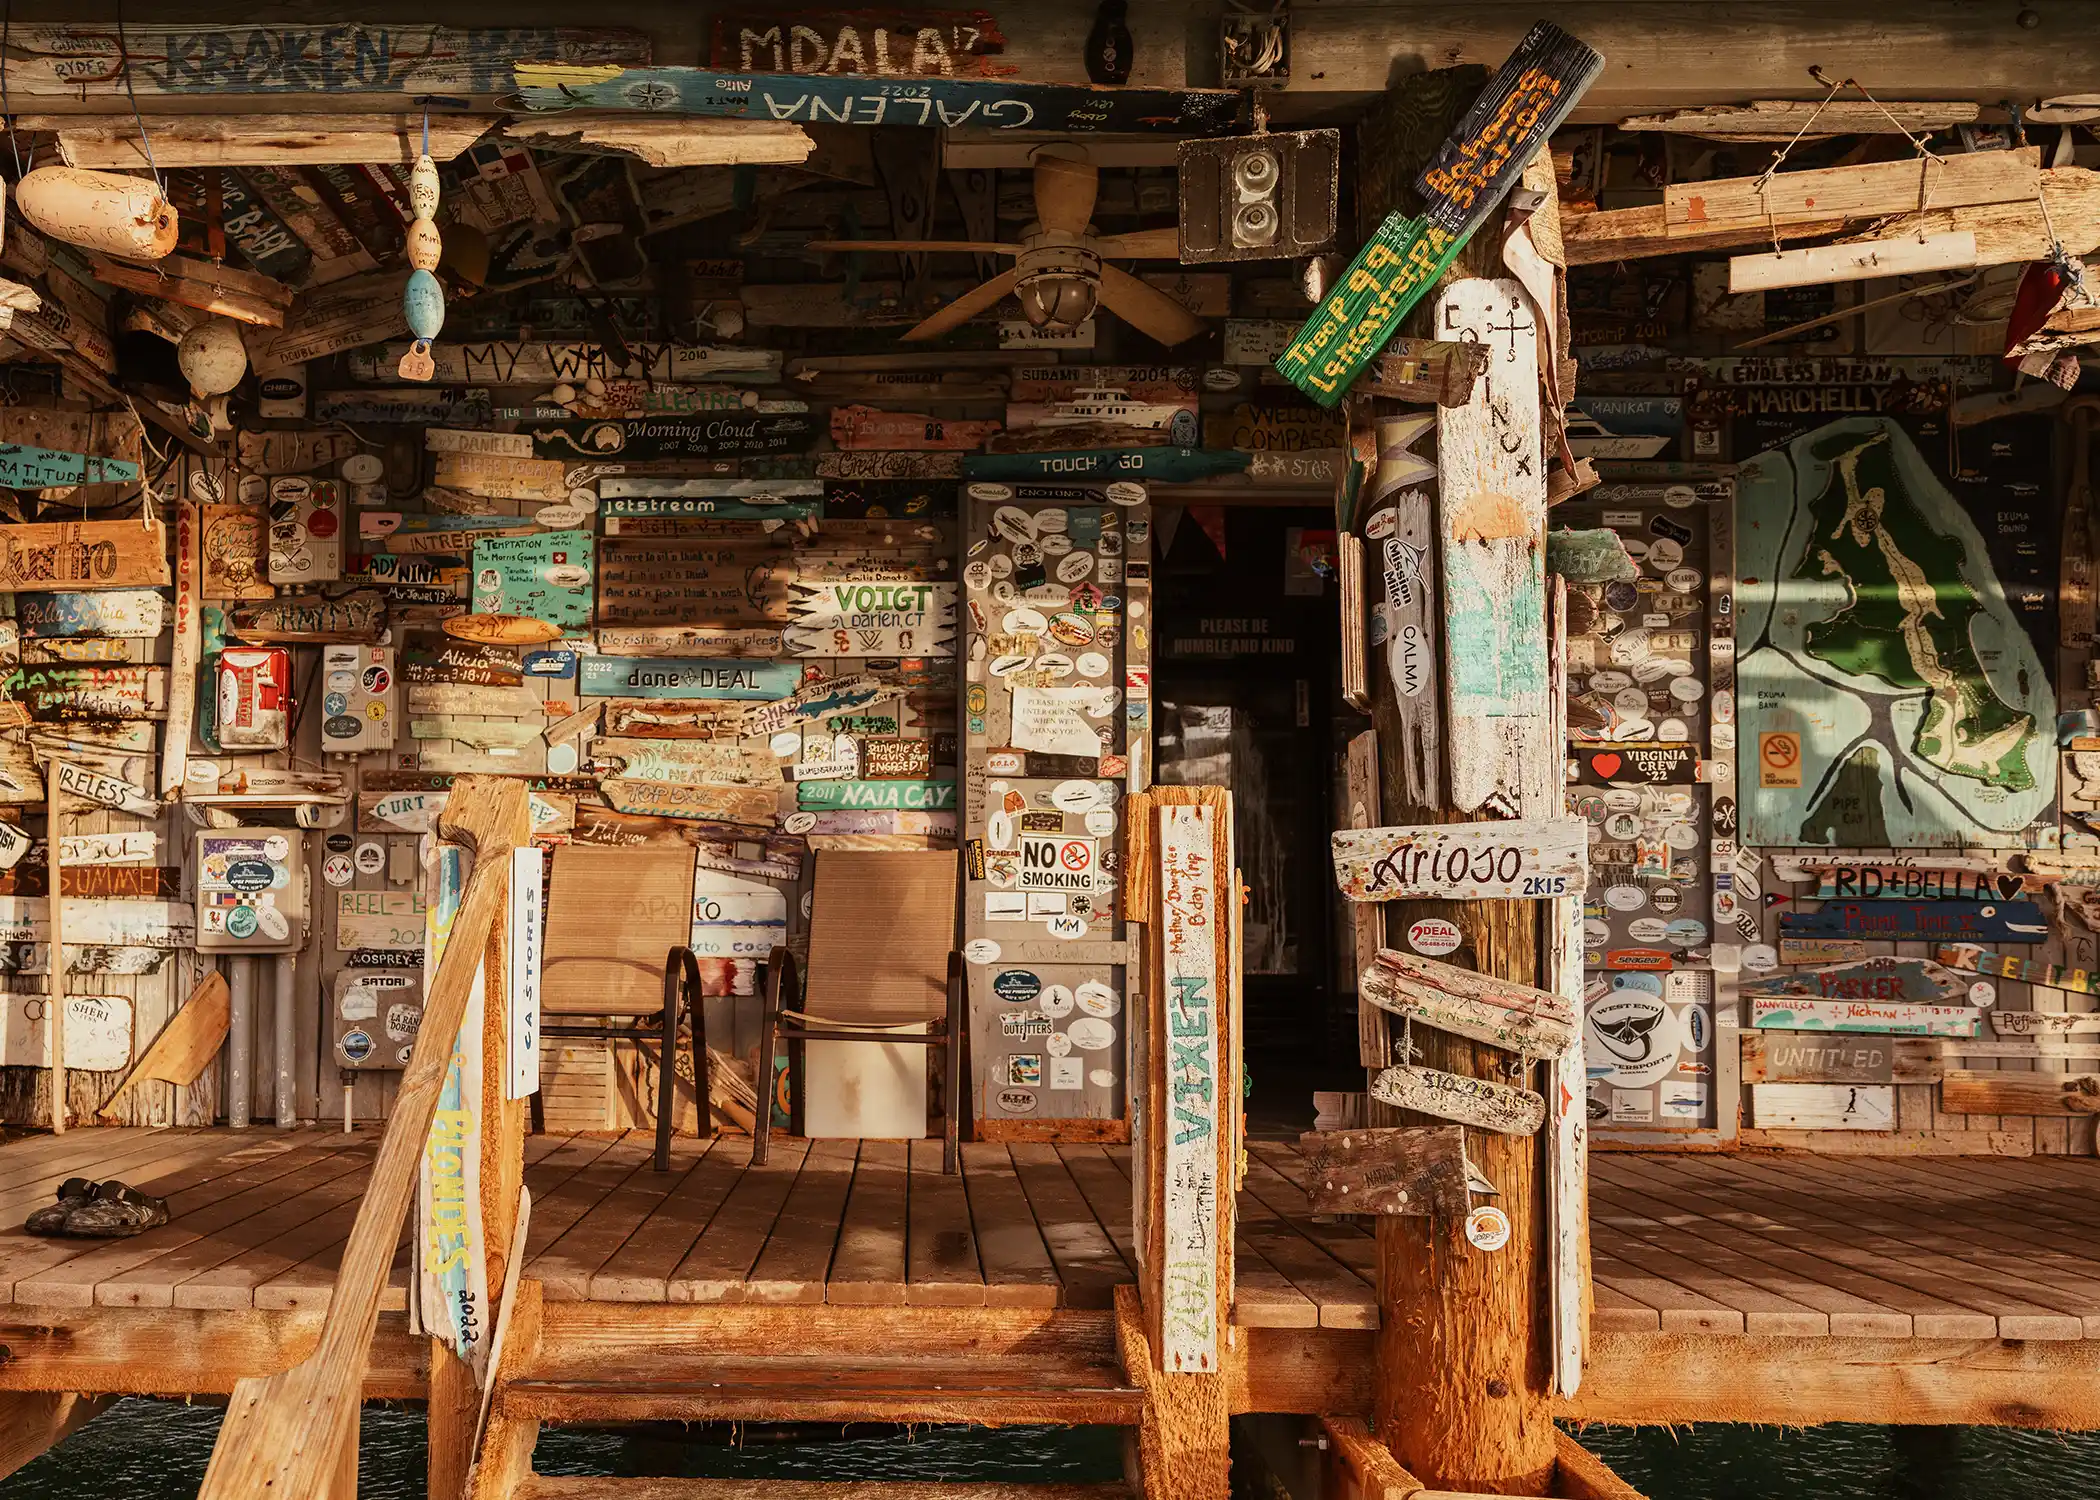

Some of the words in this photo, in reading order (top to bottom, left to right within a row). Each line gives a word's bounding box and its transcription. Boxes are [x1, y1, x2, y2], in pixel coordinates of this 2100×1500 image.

[165, 29, 392, 90] KRAKEN
[739, 25, 954, 77] MDALA
[881, 85, 932, 98] 2022
[762, 92, 1035, 130] GALENA
[462, 341, 525, 383] MY
[263, 383, 299, 393] CHIEF
[1591, 401, 1653, 415] MANIKAT
[627, 421, 701, 442] Morning
[706, 420, 757, 439] Cloud
[1233, 426, 1337, 450] COMPASS
[1040, 456, 1098, 474] TOUCH
[1119, 454, 1144, 470] GO
[605, 499, 716, 516] jetstream
[484, 539, 542, 551] TEMPTATION
[1388, 540, 1412, 605] Mission
[834, 585, 934, 614] VOIGT
[1386, 571, 1402, 609] Mike
[22, 600, 65, 625] Bella
[176, 580, 191, 635] DAYS
[905, 612, 926, 628] CT
[1200, 618, 1250, 634] PLEASE
[1251, 618, 1269, 634] BE
[1173, 638, 1229, 654] HUMBLE
[1228, 638, 1258, 654] AND
[1261, 638, 1296, 654] KIND
[438, 649, 490, 670] Alicia
[587, 662, 613, 672] 2022
[627, 668, 680, 688] dane
[700, 668, 761, 690] DEAL
[1758, 701, 1779, 710] BANK
[750, 718, 785, 736] LIFE
[1626, 750, 1688, 761] VIRGINIA
[1638, 760, 1678, 771] CREW
[806, 785, 836, 800] 2011
[903, 784, 953, 807] CAY
[1832, 797, 1860, 810] PIPE
[376, 794, 425, 819] CURT
[1024, 841, 1056, 869] NO
[1022, 872, 1091, 889] SMOKING
[1522, 876, 1566, 896] 2K15
[360, 952, 411, 966] OSPREY
[361, 977, 406, 987] SATORI
[1819, 972, 1907, 1002] PARKER
[390, 1013, 400, 1022] LA
[1596, 1003, 1630, 1016] WEST
[1633, 1003, 1661, 1014] END
[1169, 976, 1213, 1146] VIXEN
